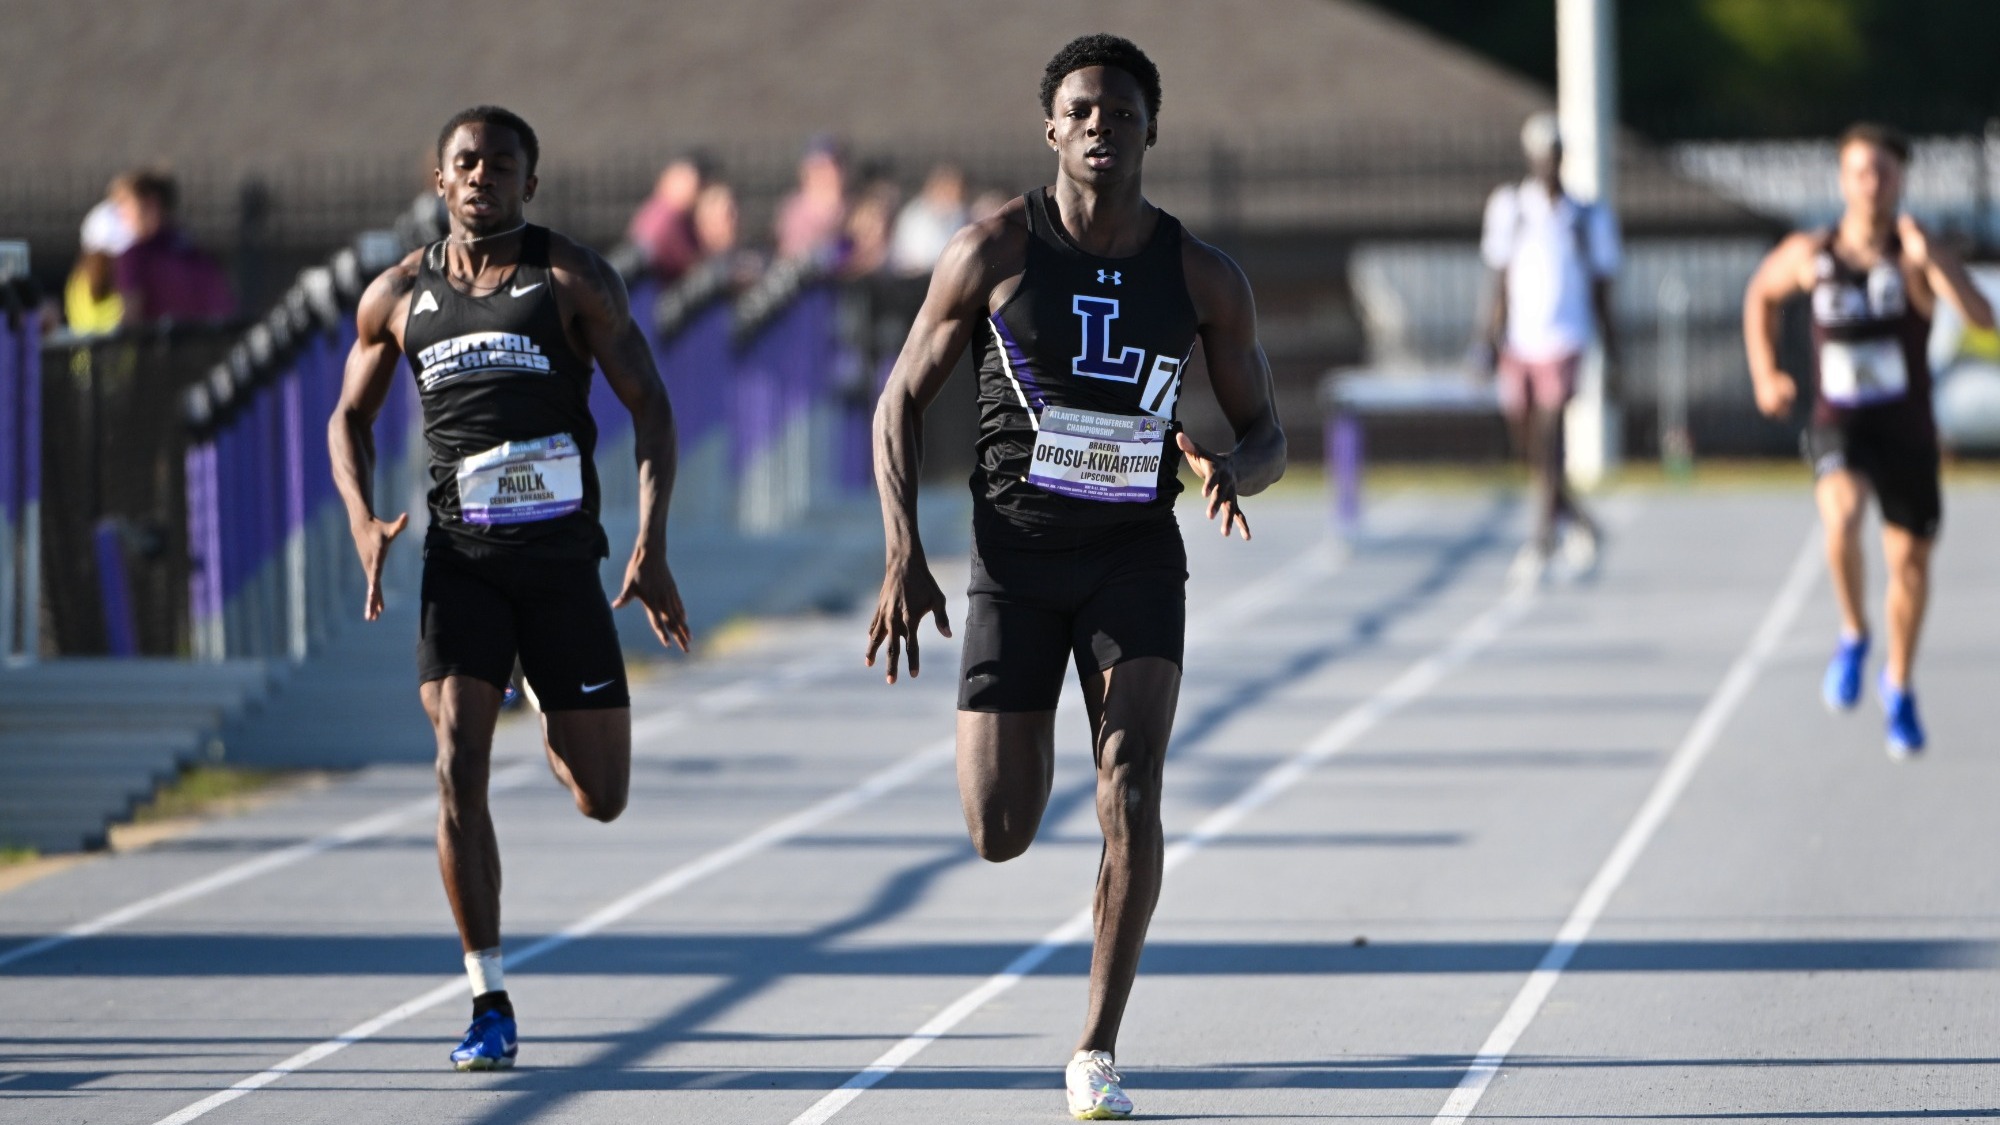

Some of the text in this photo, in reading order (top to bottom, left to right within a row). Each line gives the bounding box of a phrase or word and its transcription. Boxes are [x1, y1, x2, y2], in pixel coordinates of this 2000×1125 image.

[1072, 294, 1146, 384] L
[417, 331, 541, 369] CENTRAL
[1049, 410, 1134, 429] ATLANTIC SUN CONFERENCE
[1066, 423, 1115, 436] CHAMPIONSHIP
[1088, 441, 1121, 453] BRAEDEN
[1036, 443, 1159, 473] OFOSU-KWARTENG
[498, 472, 546, 494] PAULK
[1080, 471, 1117, 483] LIPSCOMB
[520, 491, 555, 502] ARKANSAS
